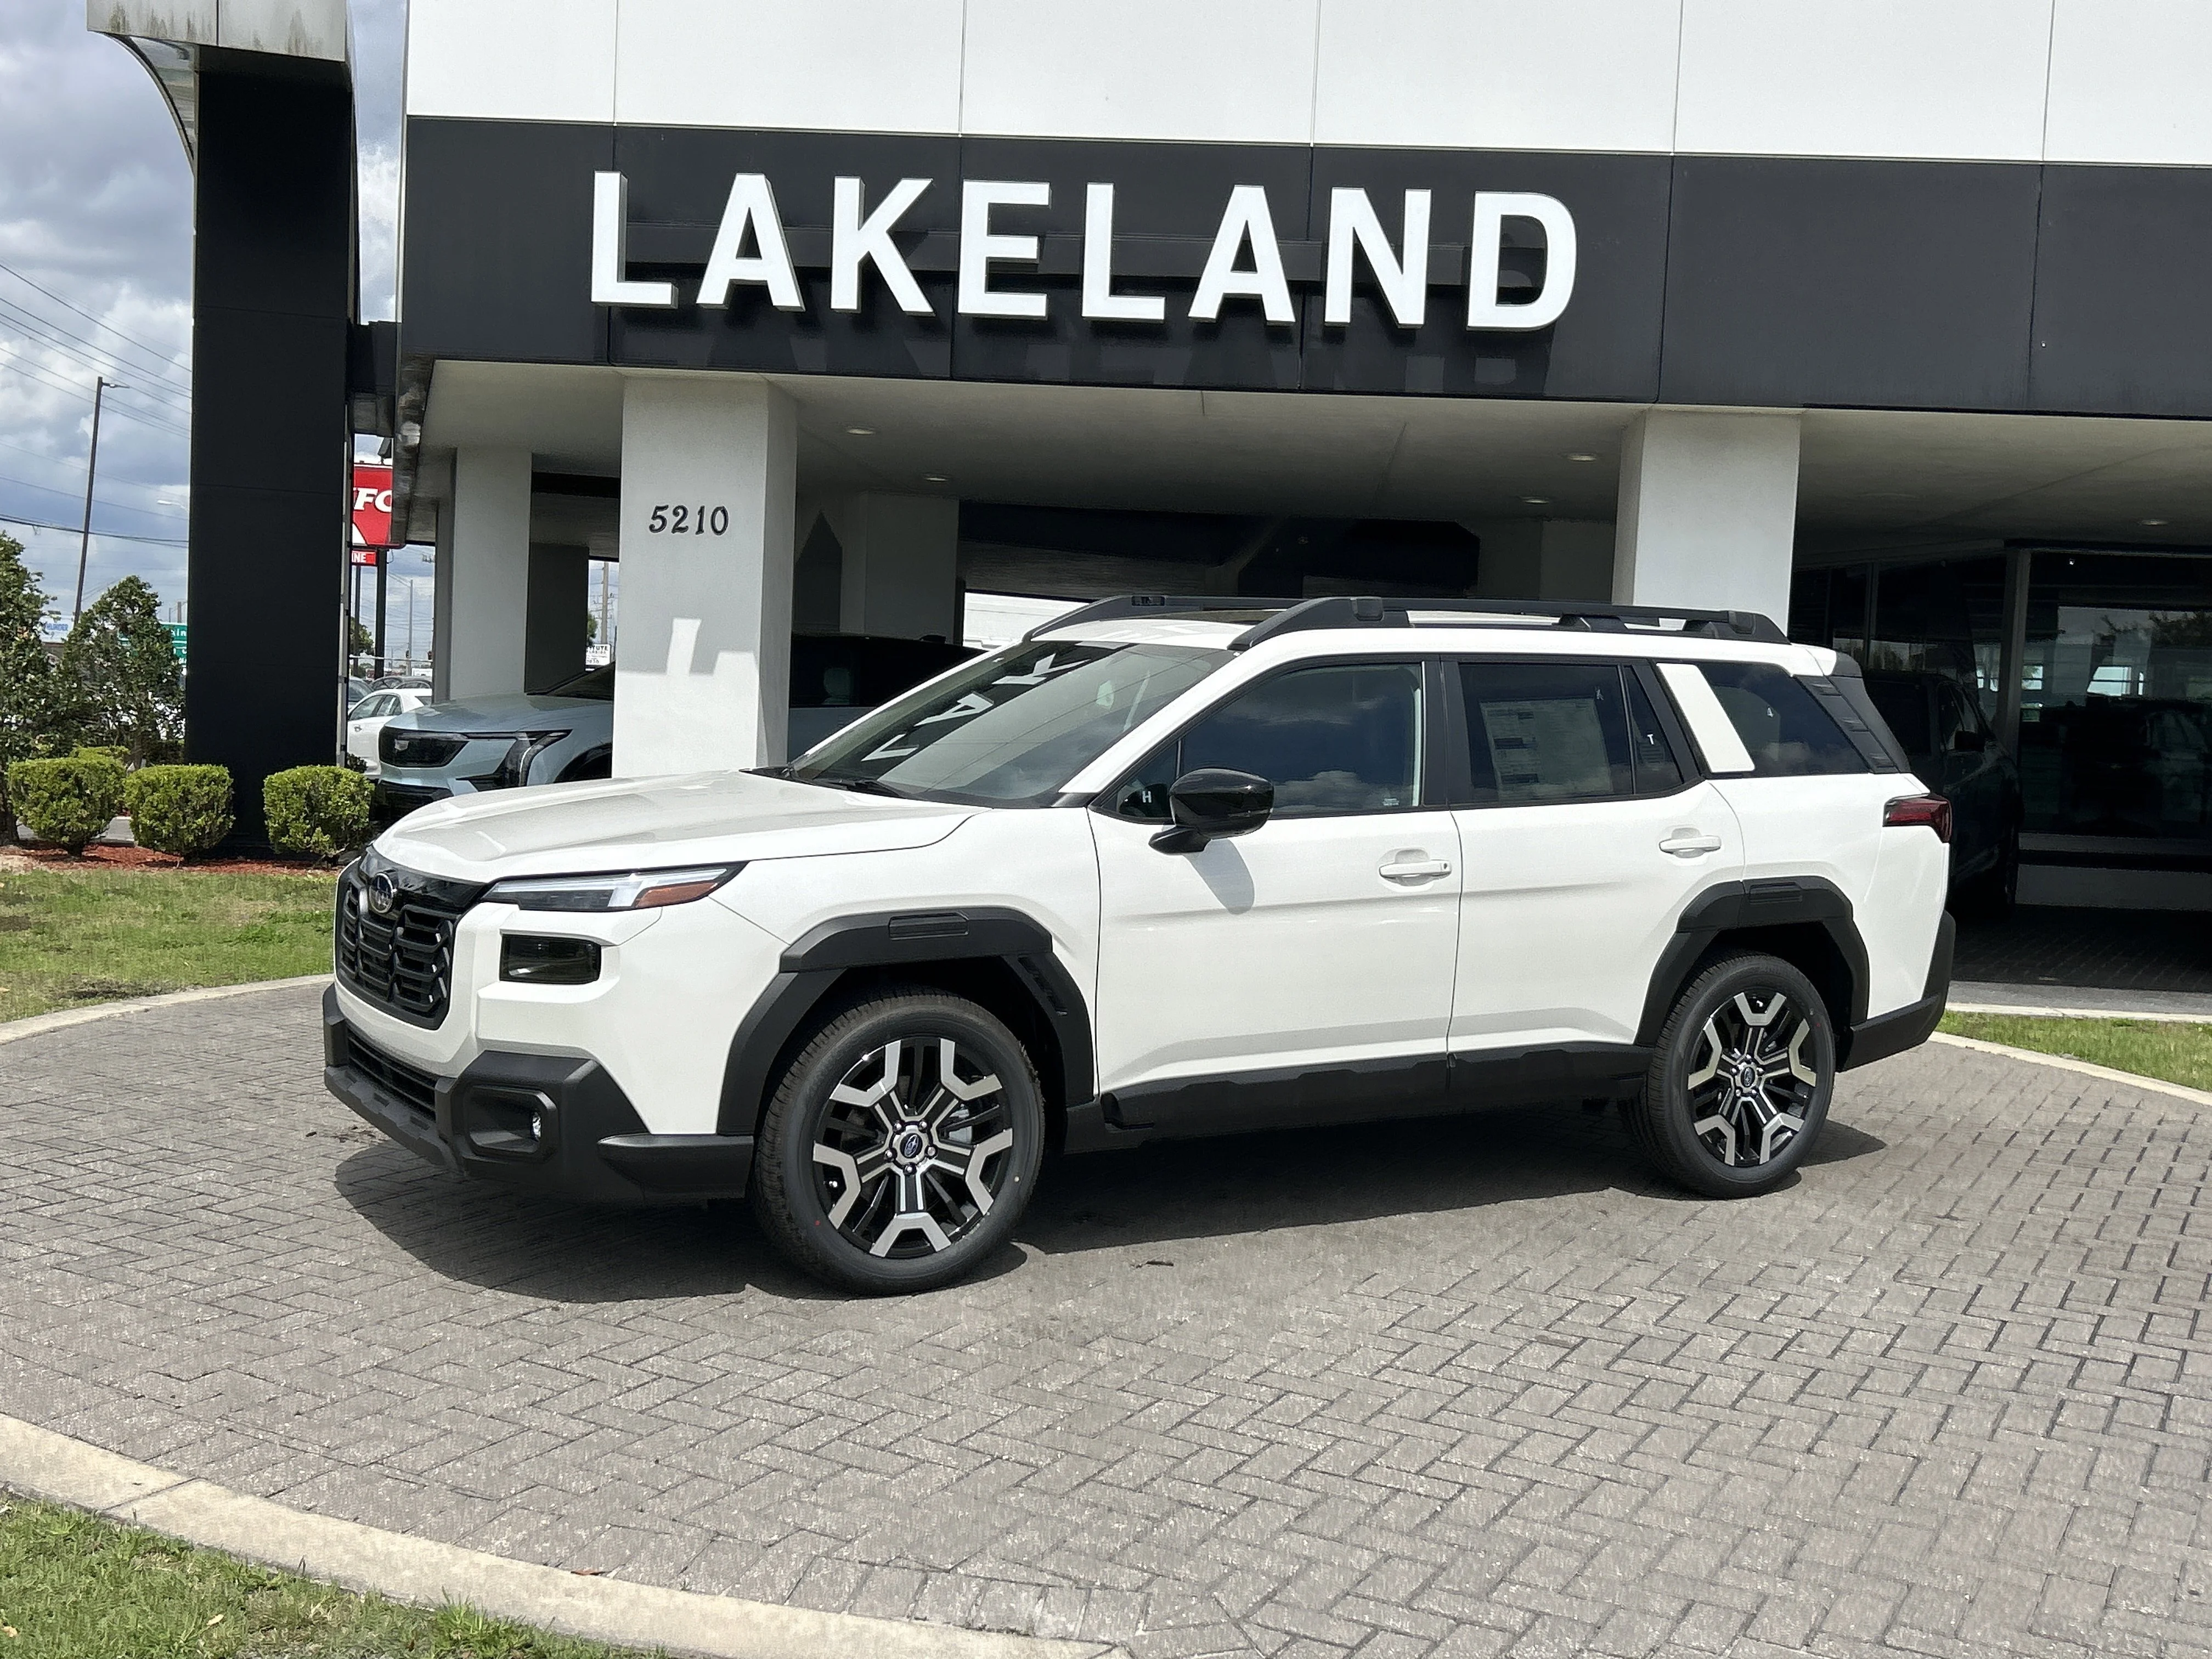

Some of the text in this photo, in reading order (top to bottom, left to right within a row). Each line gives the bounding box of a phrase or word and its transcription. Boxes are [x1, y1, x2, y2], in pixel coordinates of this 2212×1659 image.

[591, 171, 1576, 331] LAKELAND
[353, 487, 392, 513] FC
[649, 505, 729, 535] 5210
